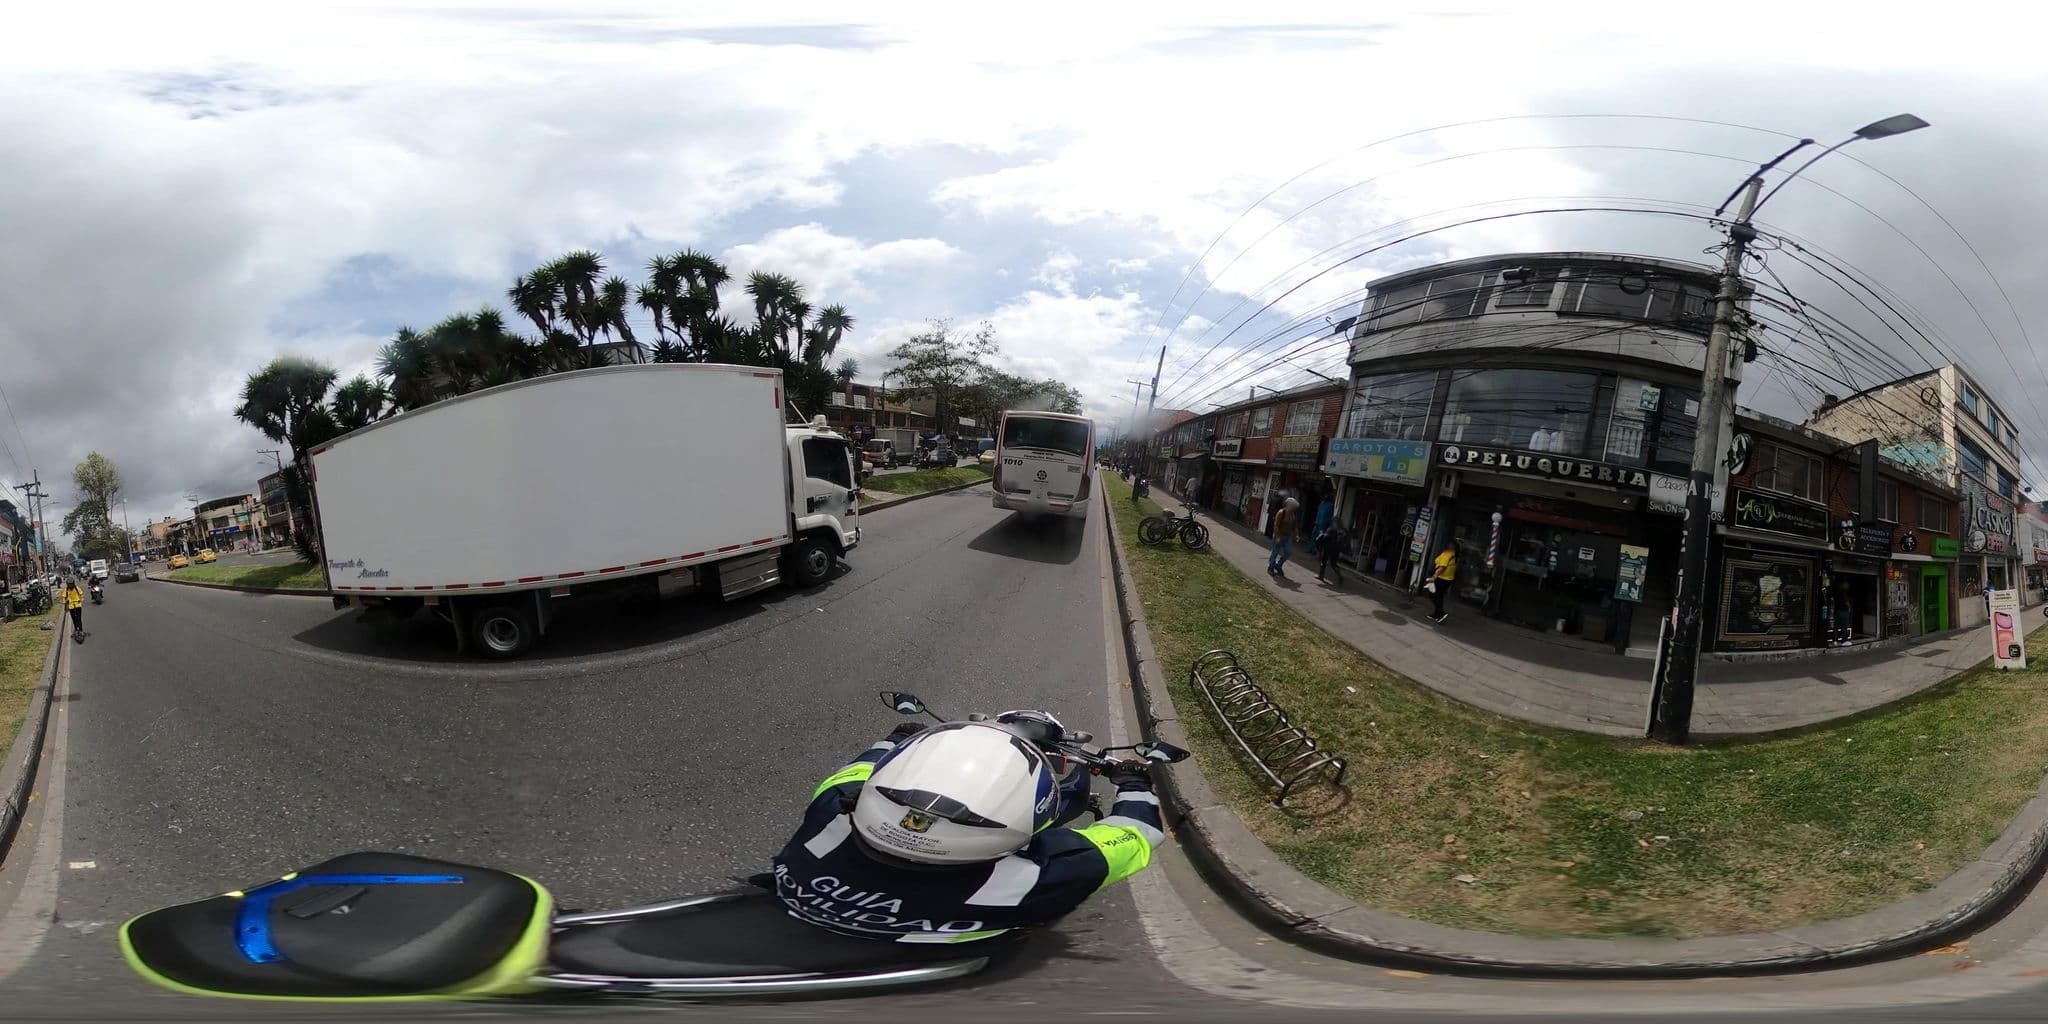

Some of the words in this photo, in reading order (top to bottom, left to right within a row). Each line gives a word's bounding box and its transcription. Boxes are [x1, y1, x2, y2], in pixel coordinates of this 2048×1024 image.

[1004, 458, 1023, 466] 1010
[1466, 450, 1648, 487] PELUQUERIA
[1977, 507, 2012, 536] CASINO
[775, 863, 984, 932] MOVILIDAD
[810, 875, 904, 913] GUÍA
